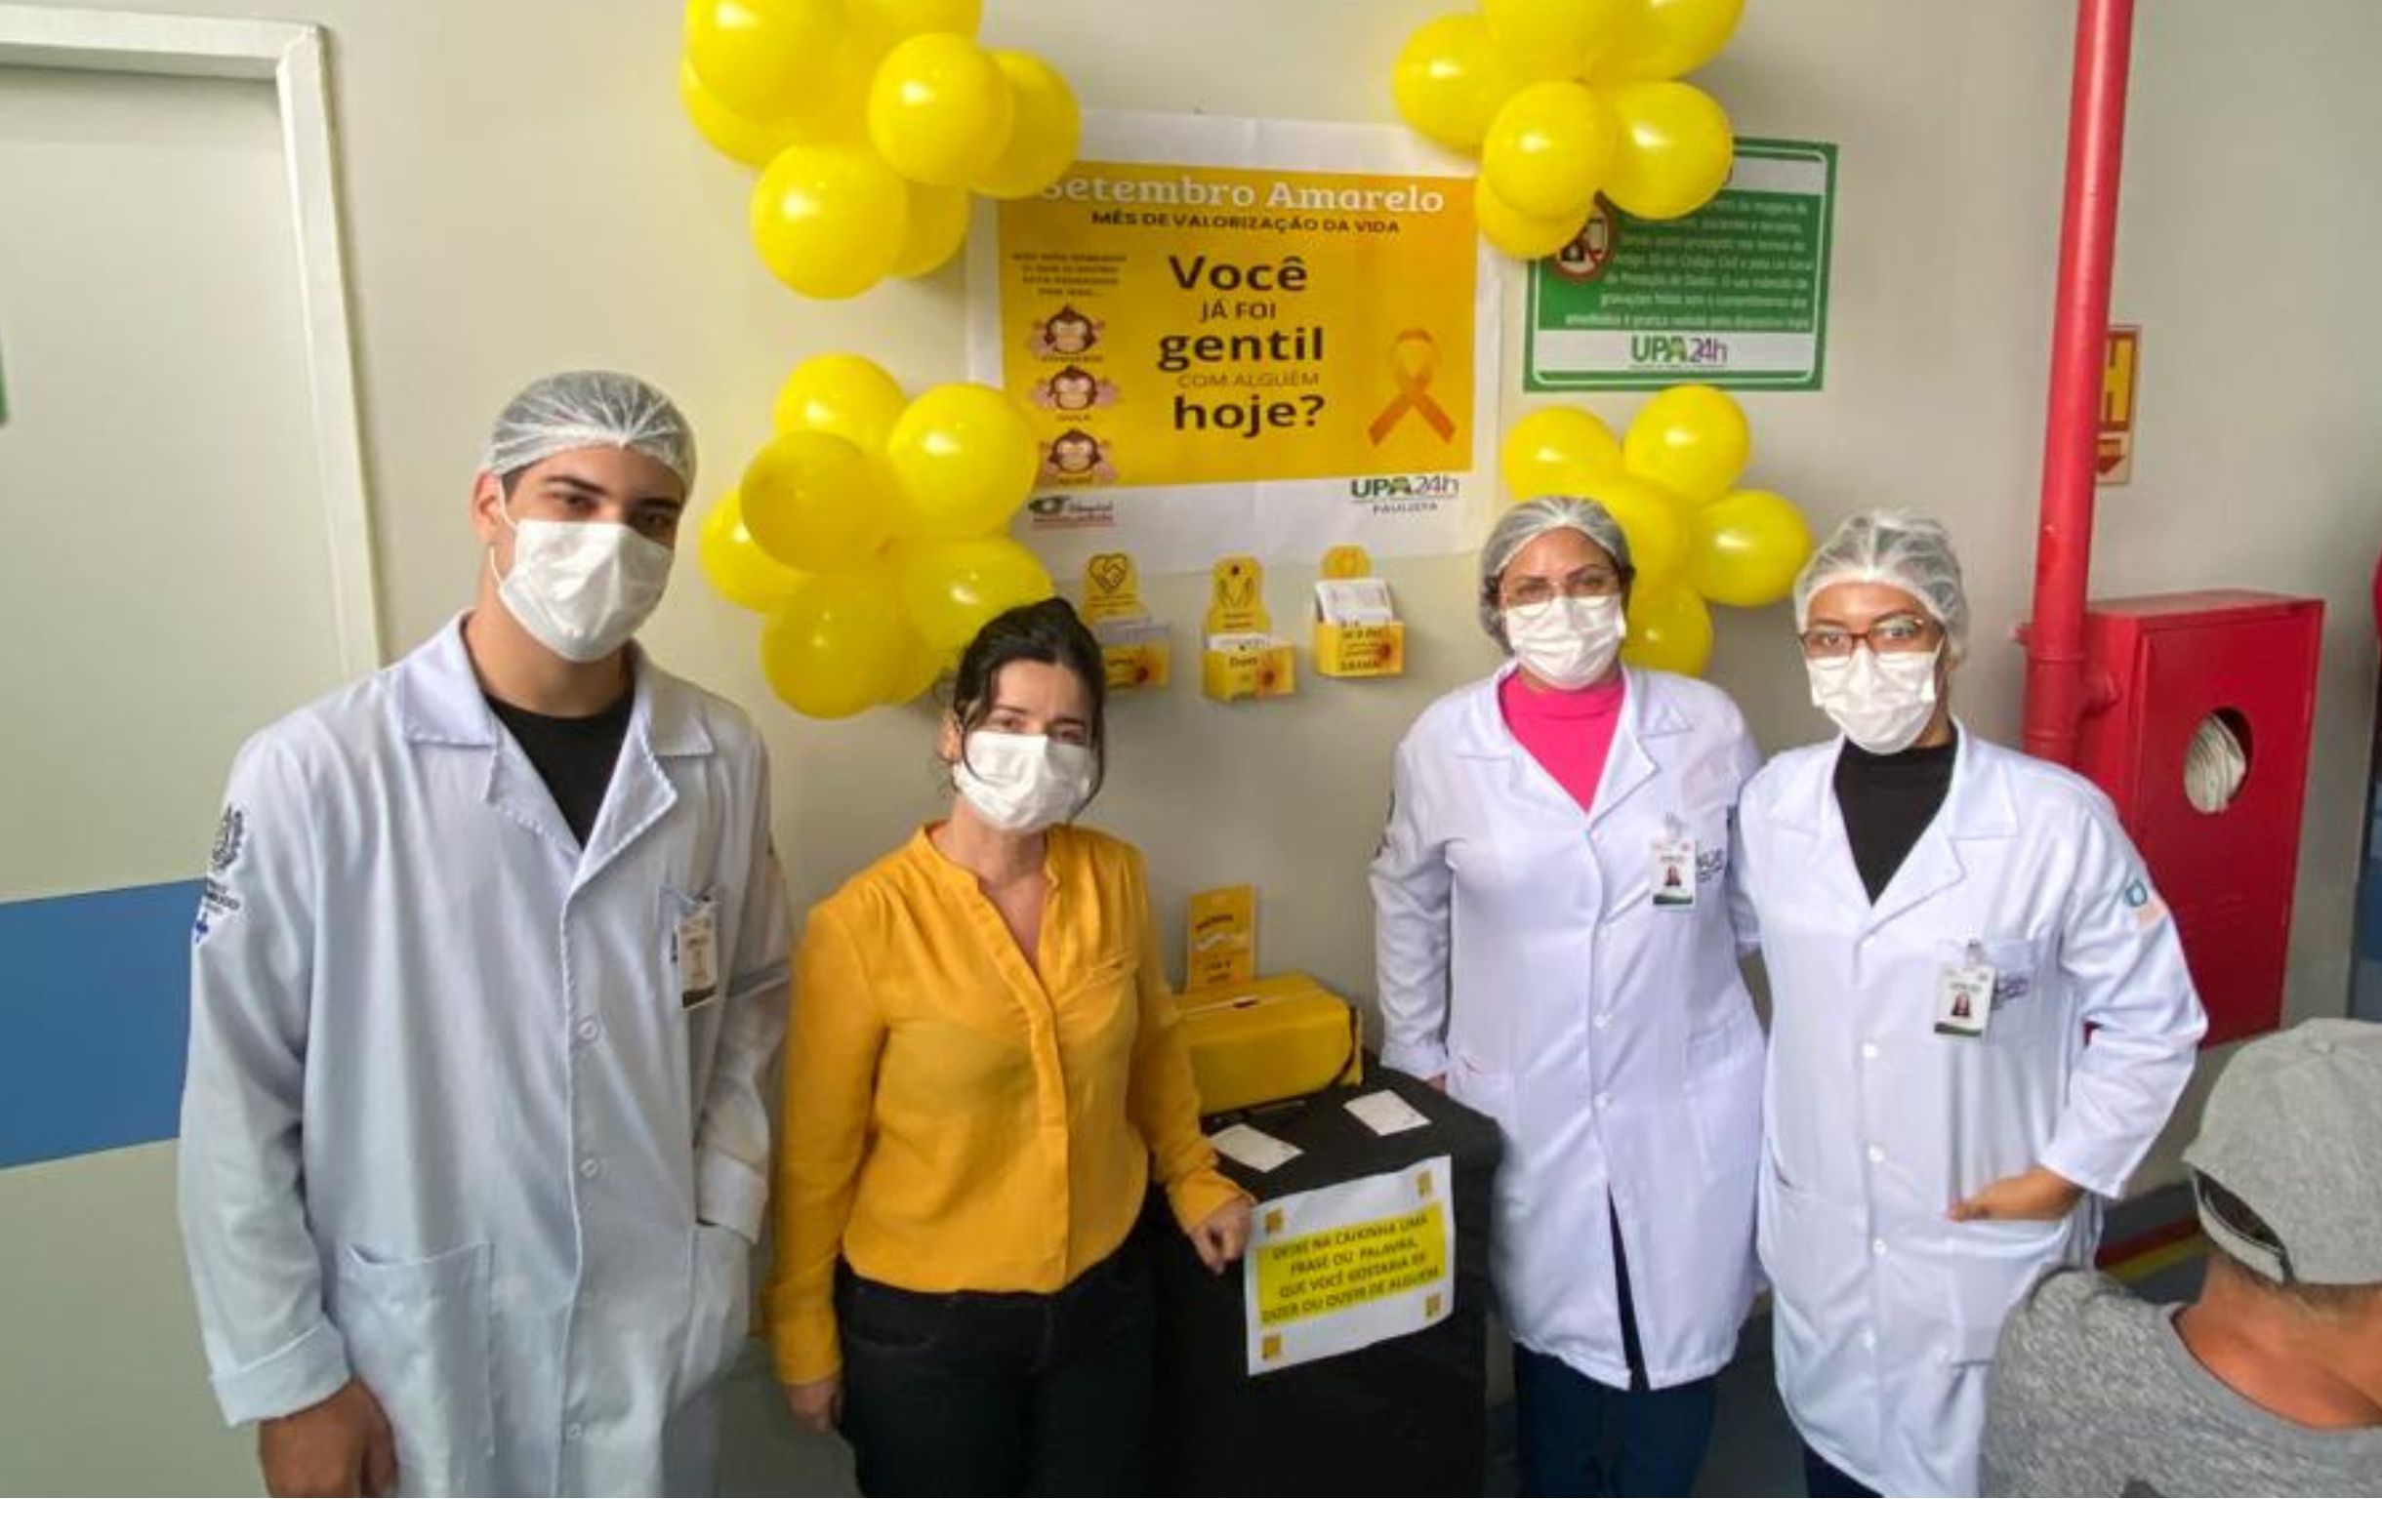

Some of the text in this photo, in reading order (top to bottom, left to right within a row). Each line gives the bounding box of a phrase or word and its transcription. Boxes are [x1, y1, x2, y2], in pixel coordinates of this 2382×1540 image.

[1267, 182, 1444, 213] Amarelo
[1091, 211, 1400, 234] MÊS DE VALORIZAÇÃO DA VIDA
[1169, 255, 1307, 292] Você
[1199, 299, 1276, 323] JÁ FOI
[1157, 327, 1324, 373] gentil
[1178, 373, 1229, 388] COM
[1173, 393, 1326, 439] hoje?
[1314, 1234, 1332, 1249] NA
[1400, 1213, 1428, 1232] UMA
[1291, 1255, 1329, 1277] FRASE
[1334, 1250, 1353, 1267] OU
[1280, 1280, 1307, 1299] QUE
[1301, 1296, 1324, 1314] OU
